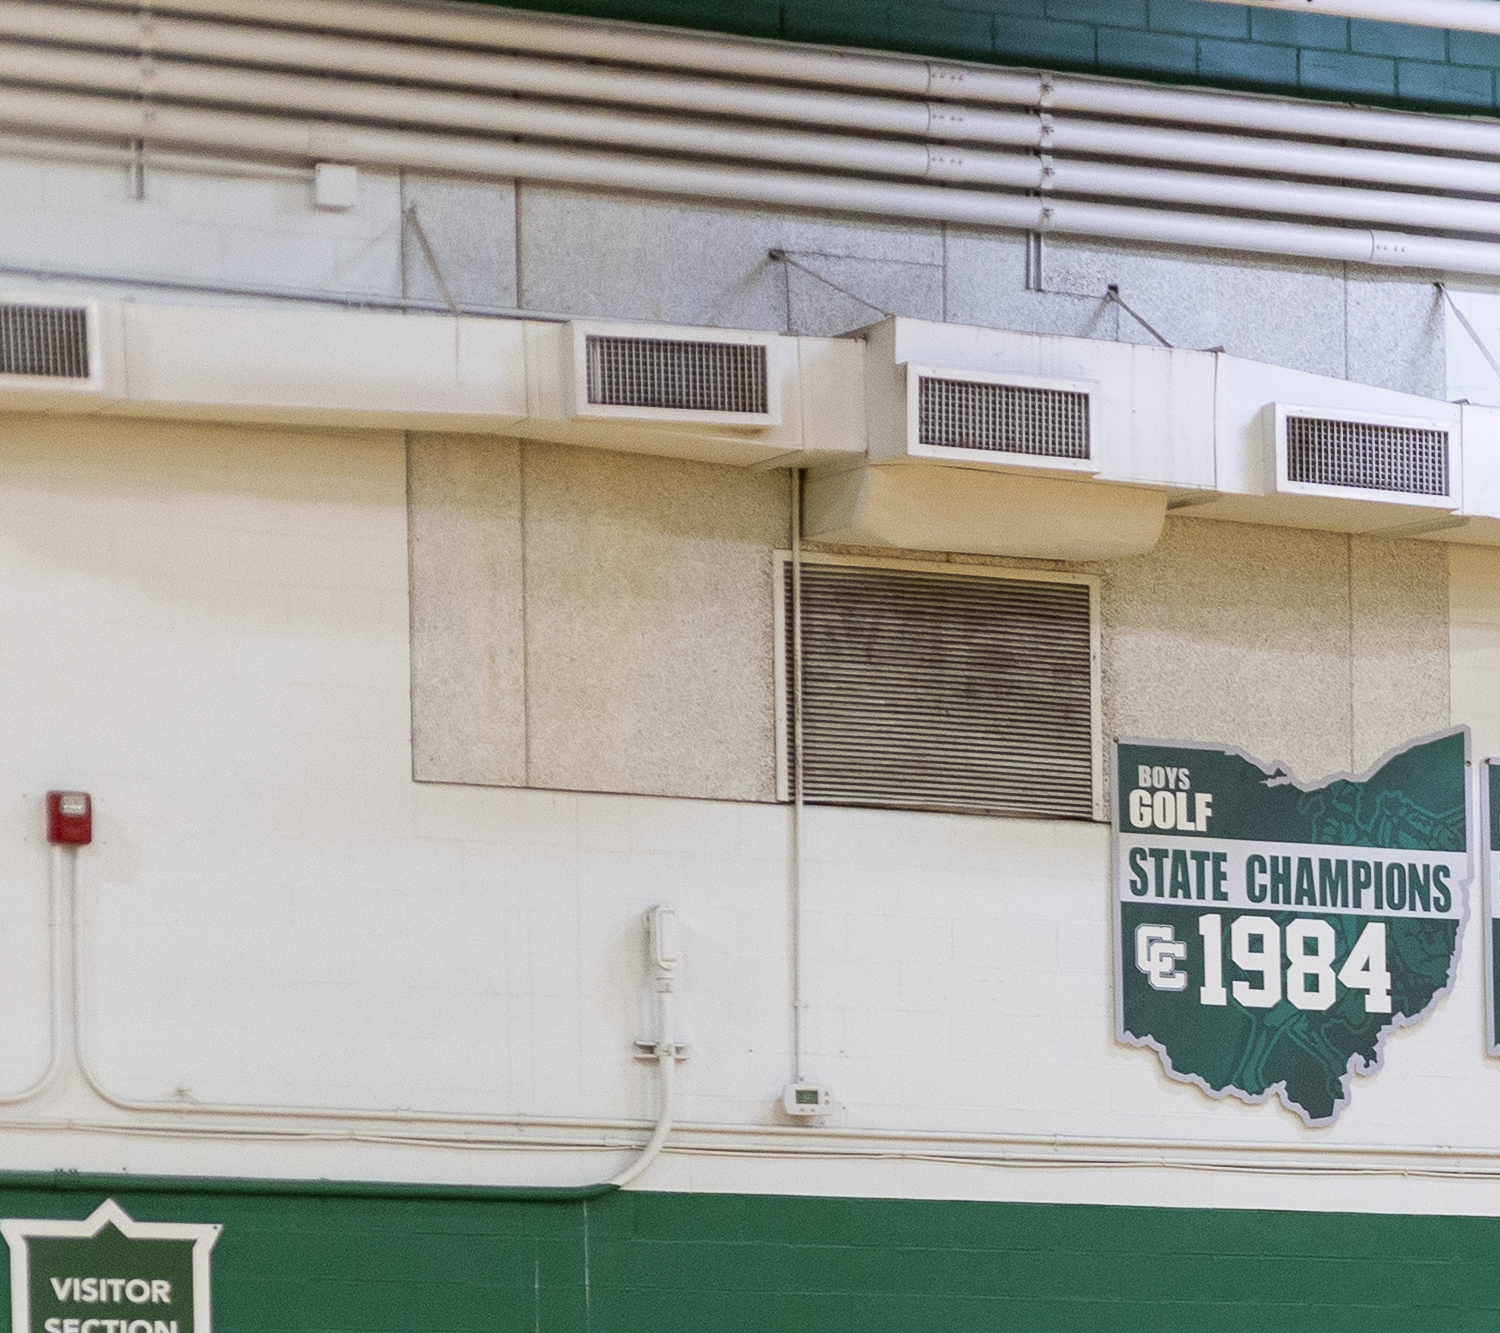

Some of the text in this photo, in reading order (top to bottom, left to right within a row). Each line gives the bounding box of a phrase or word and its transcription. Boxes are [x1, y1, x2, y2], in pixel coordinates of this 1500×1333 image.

[1138, 765, 1190, 791] BOYS
[1129, 790, 1212, 832] GOLF
[1129, 849, 1451, 913] STATE CHAMPIONS
[1199, 914, 1392, 1014] 1984
[50, 1276, 171, 1304] VISITOR
